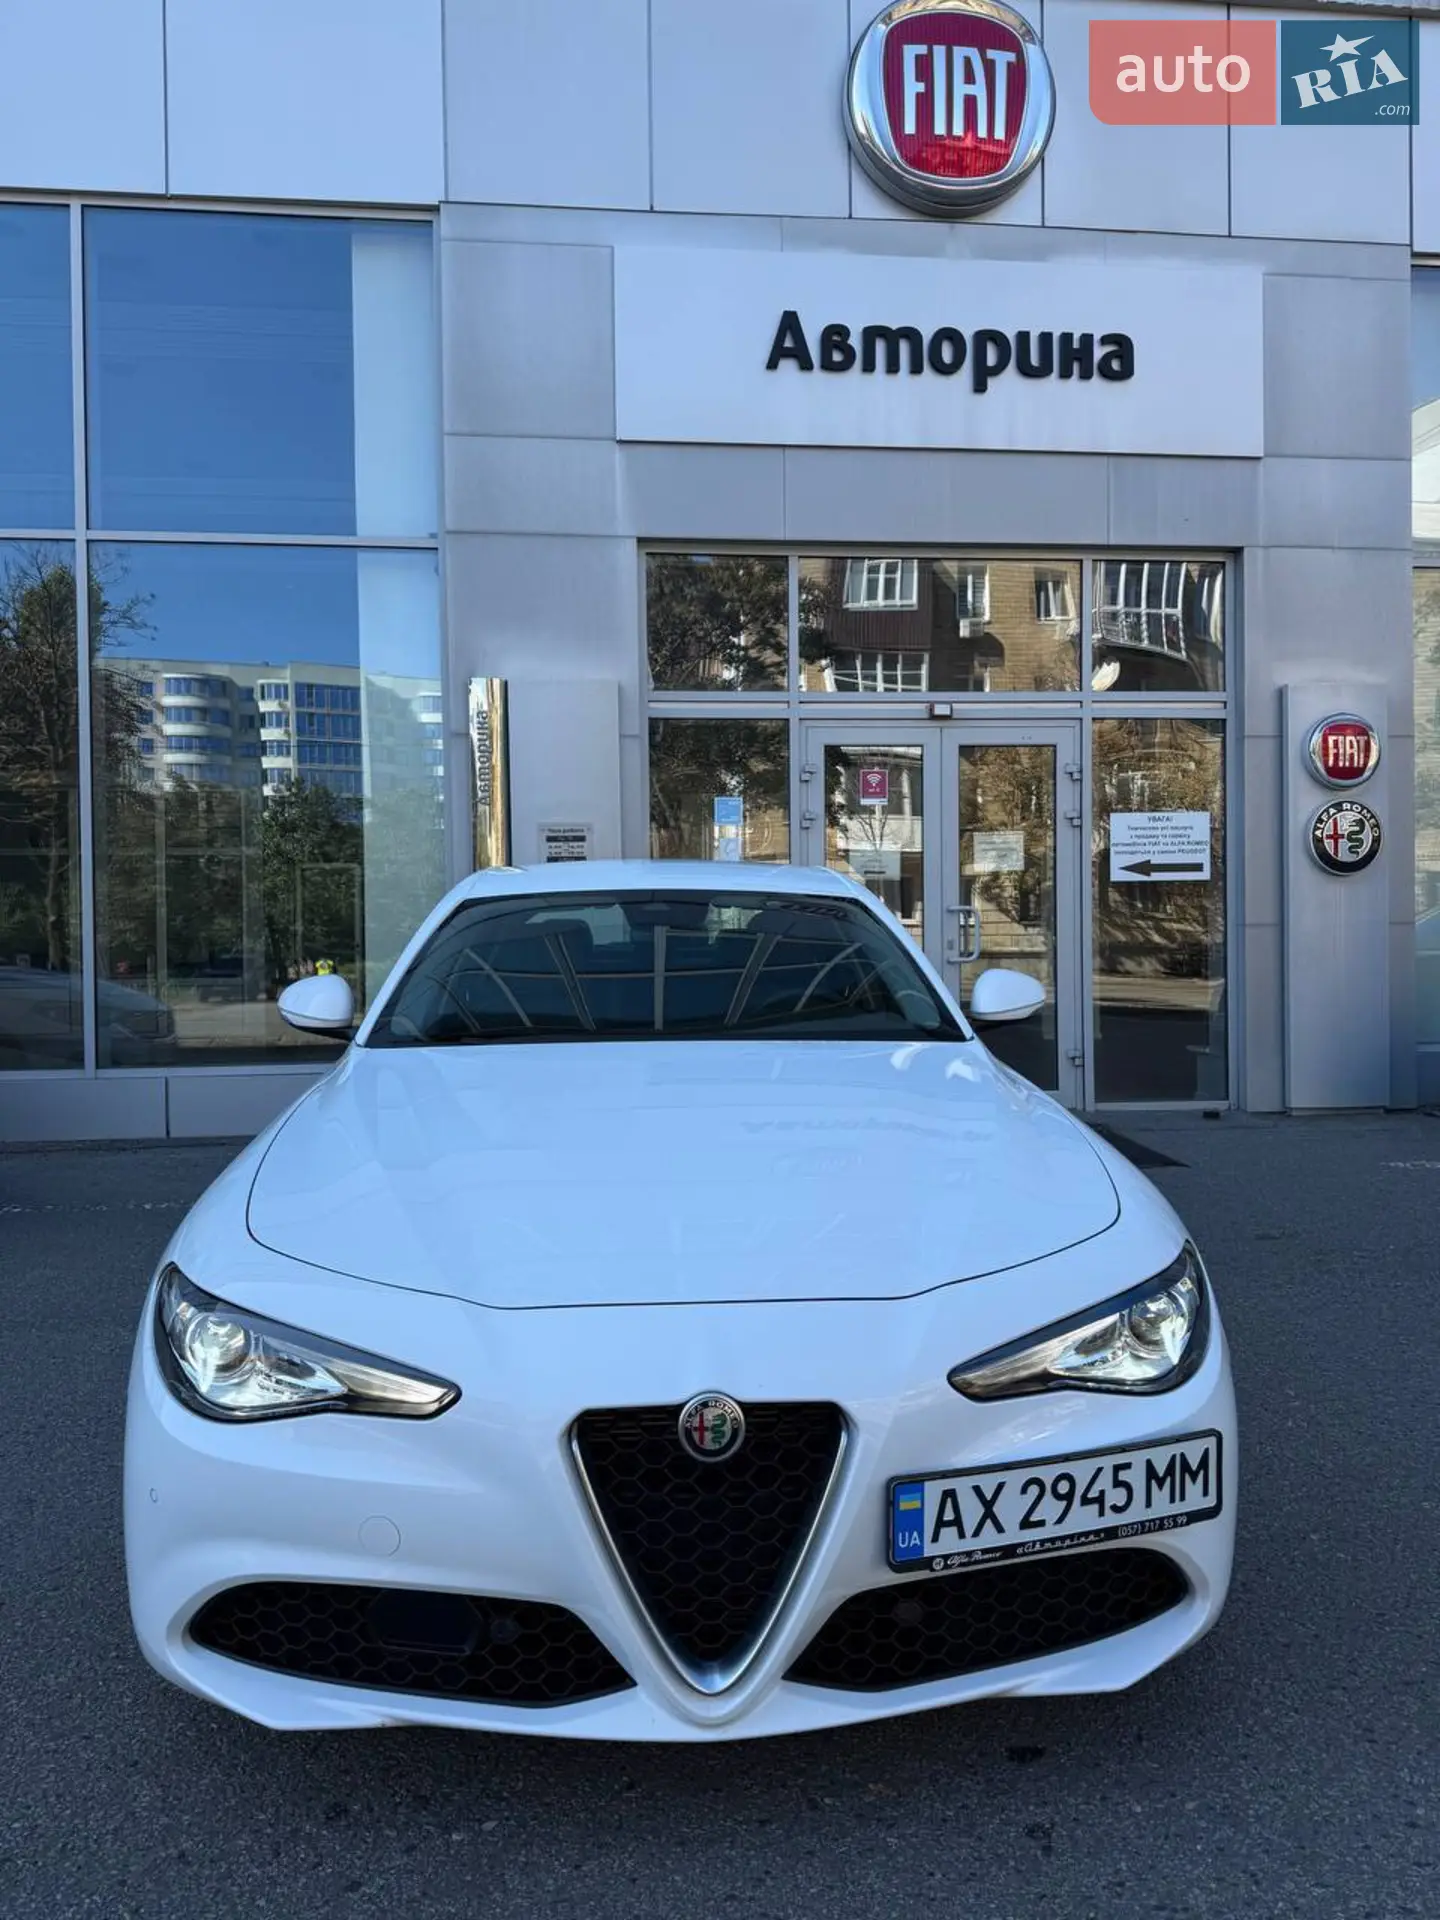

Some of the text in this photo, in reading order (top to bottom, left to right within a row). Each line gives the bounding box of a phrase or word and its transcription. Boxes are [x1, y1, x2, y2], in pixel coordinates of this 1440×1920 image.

[902, 43, 1017, 141] FIAT
[766, 310, 1135, 393] Авторина
[1327, 736, 1368, 768] FIAT
[1147, 815, 1174, 823] УВАГА!
[1314, 802, 1380, 838] ALFA ROMEO
[708, 1400, 739, 1428] ROMEO
[930, 1446, 1210, 1544] AX 2945 MM
[898, 1531, 921, 1548] UA
[1118, 1524, 1142, 1537] (057)
[1163, 1517, 1174, 1529] 55
[1175, 1514, 1188, 1527] 99
